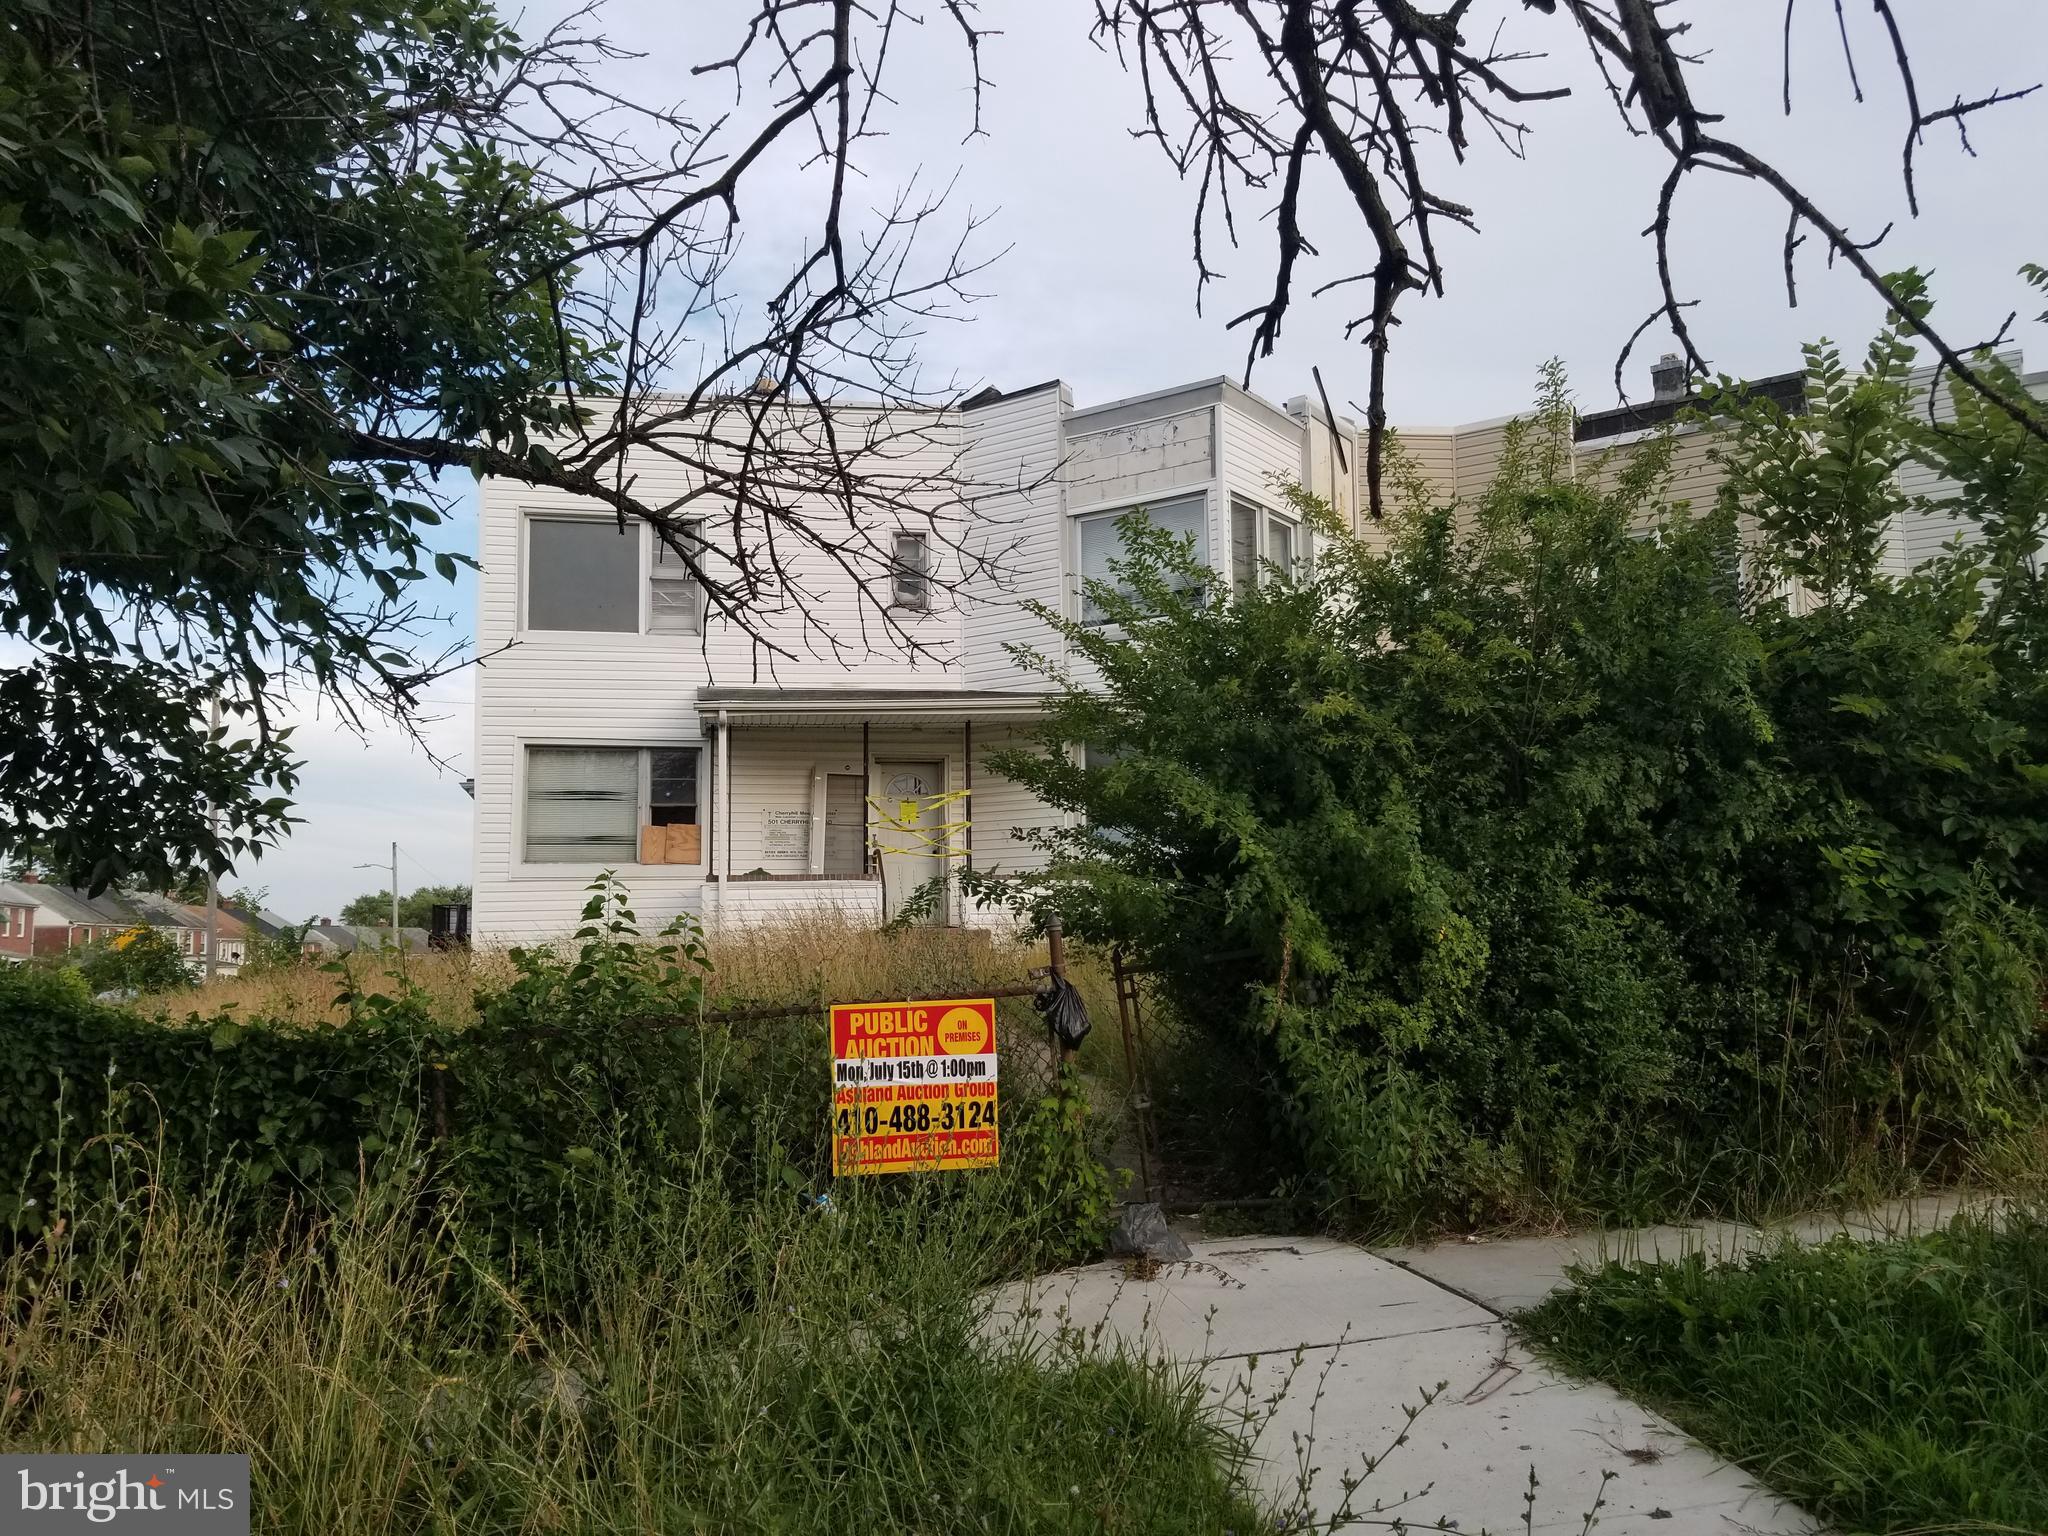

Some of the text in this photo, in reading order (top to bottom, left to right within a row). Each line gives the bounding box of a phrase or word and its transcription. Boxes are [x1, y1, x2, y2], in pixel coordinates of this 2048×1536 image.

[849, 1009, 928, 1036] PUBLIC
[957, 1020, 968, 1030] ON
[845, 1035, 935, 1059] AUCTION
[944, 1031, 981, 1043] PREMISES
[869, 1060, 894, 1082] July
[896, 1059, 924, 1079] 15th
[926, 1060, 939, 1078] @
[940, 1058, 986, 1078] 1:00pm
[896, 1083, 949, 1101] Auction
[954, 1081, 995, 1099] Group
[837, 1100, 995, 1136] 410-488-3124
